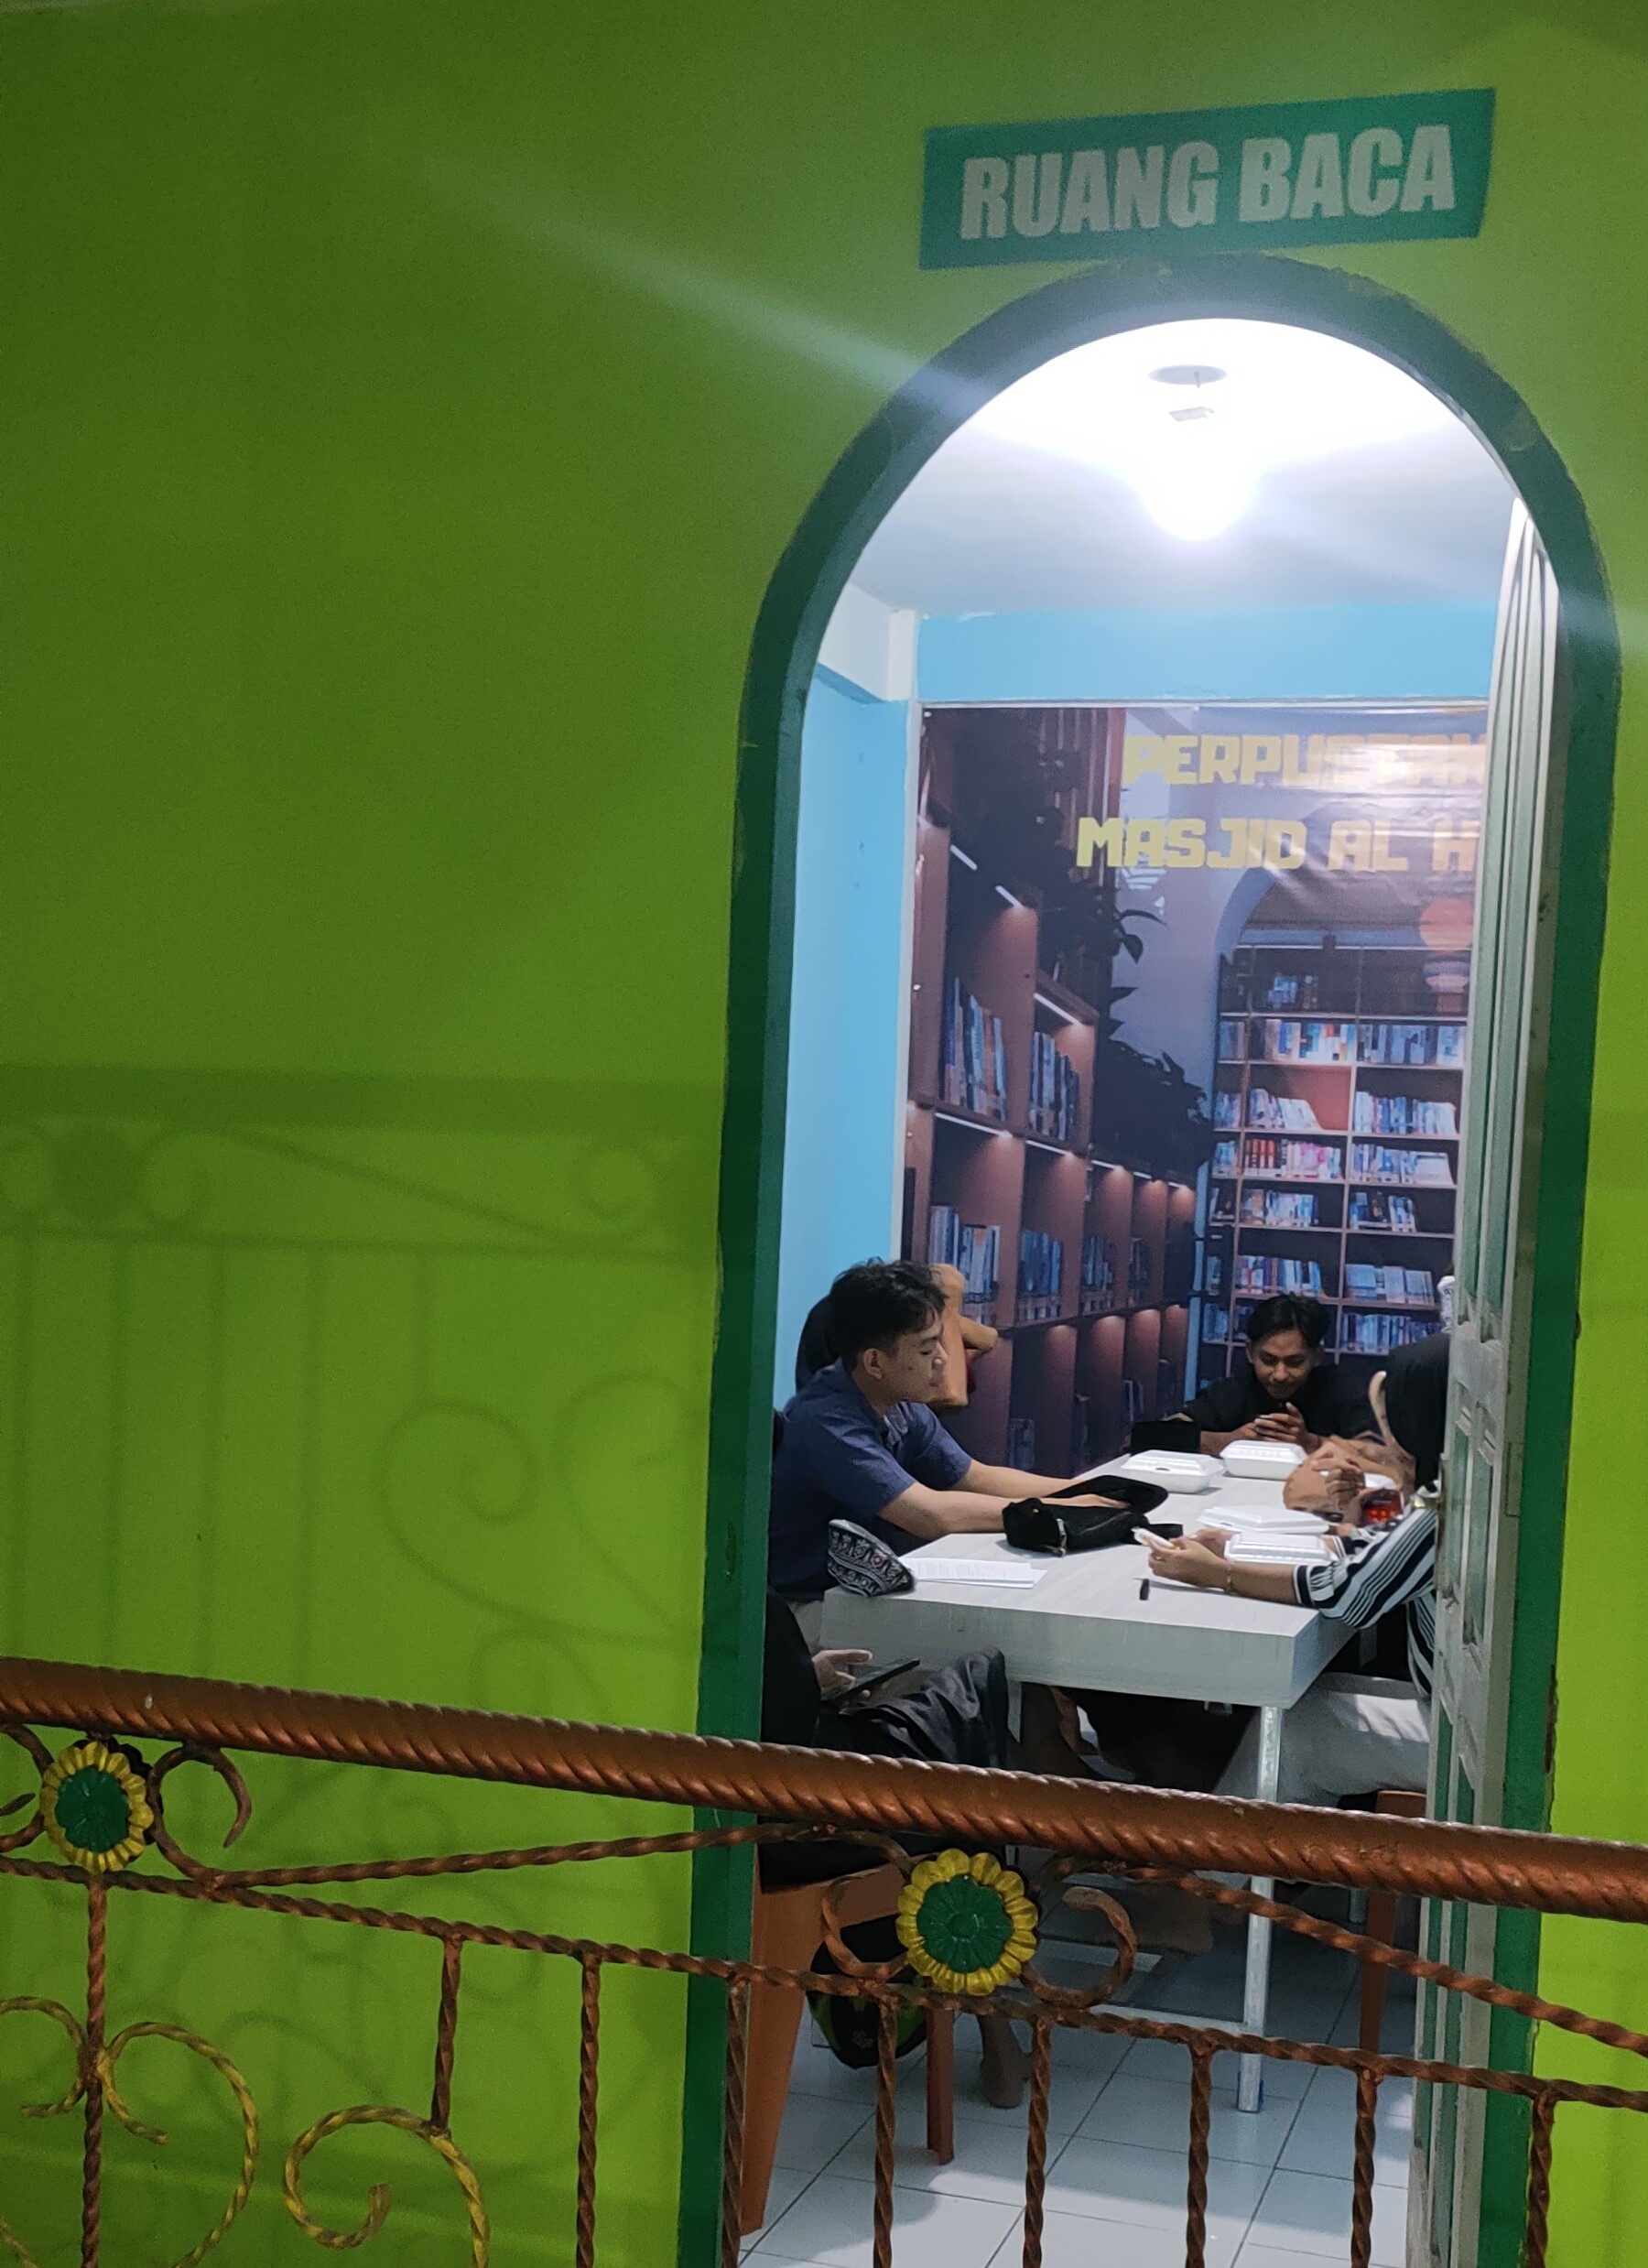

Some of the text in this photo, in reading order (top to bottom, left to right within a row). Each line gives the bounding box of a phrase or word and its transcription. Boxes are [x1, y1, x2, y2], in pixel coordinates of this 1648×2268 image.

[960, 124, 1455, 241] RUANG BACA
[1076, 816, 1307, 870] MASJID
[1328, 820, 1408, 873] AL
